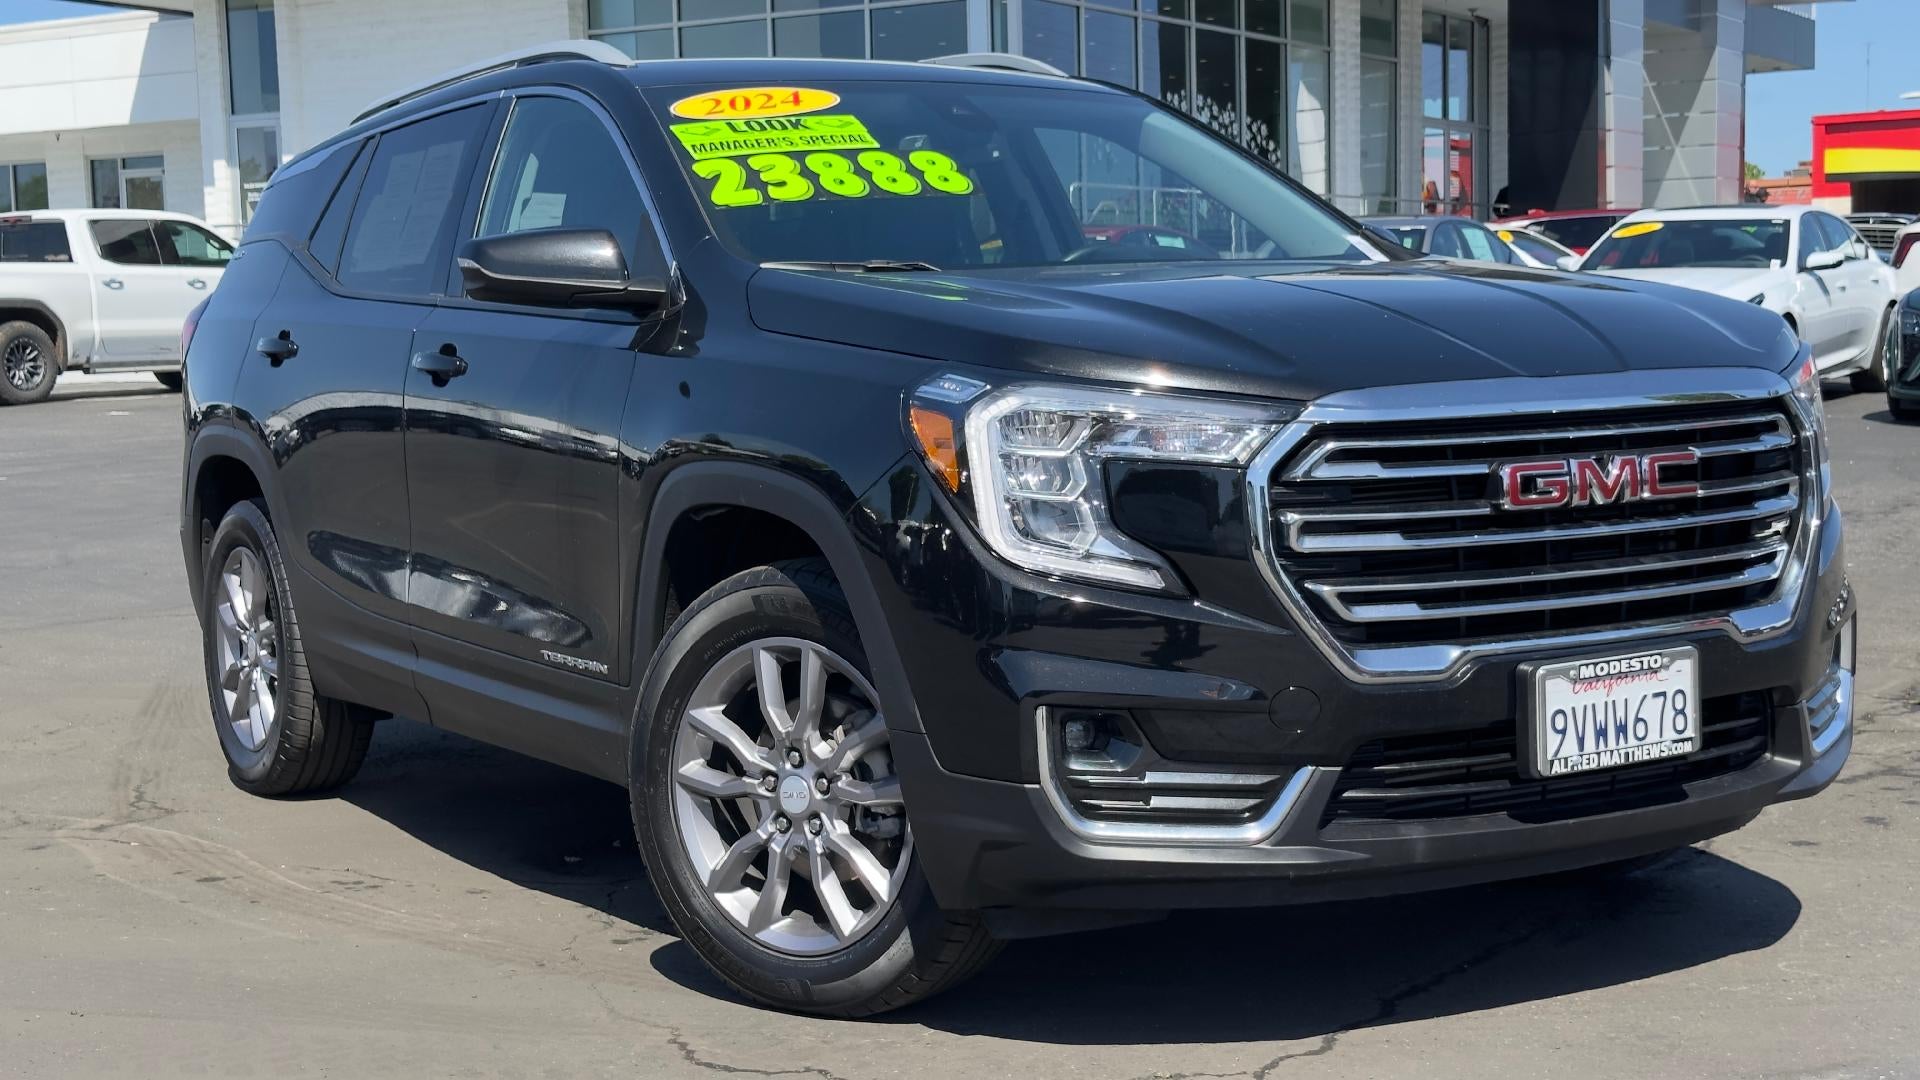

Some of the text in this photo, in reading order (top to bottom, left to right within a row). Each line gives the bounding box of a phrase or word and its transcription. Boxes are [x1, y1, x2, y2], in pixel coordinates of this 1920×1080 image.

[702, 91, 803, 115] 2024
[725, 118, 811, 134] LOOK
[691, 133, 869, 154] MANAGER'S SPECIAL
[692, 151, 973, 207] 23888
[1501, 452, 1699, 510] GMC
[540, 649, 608, 675] TERRAIN
[1579, 655, 1662, 679] MODESTO
[1551, 689, 1688, 758] 9VWW678
